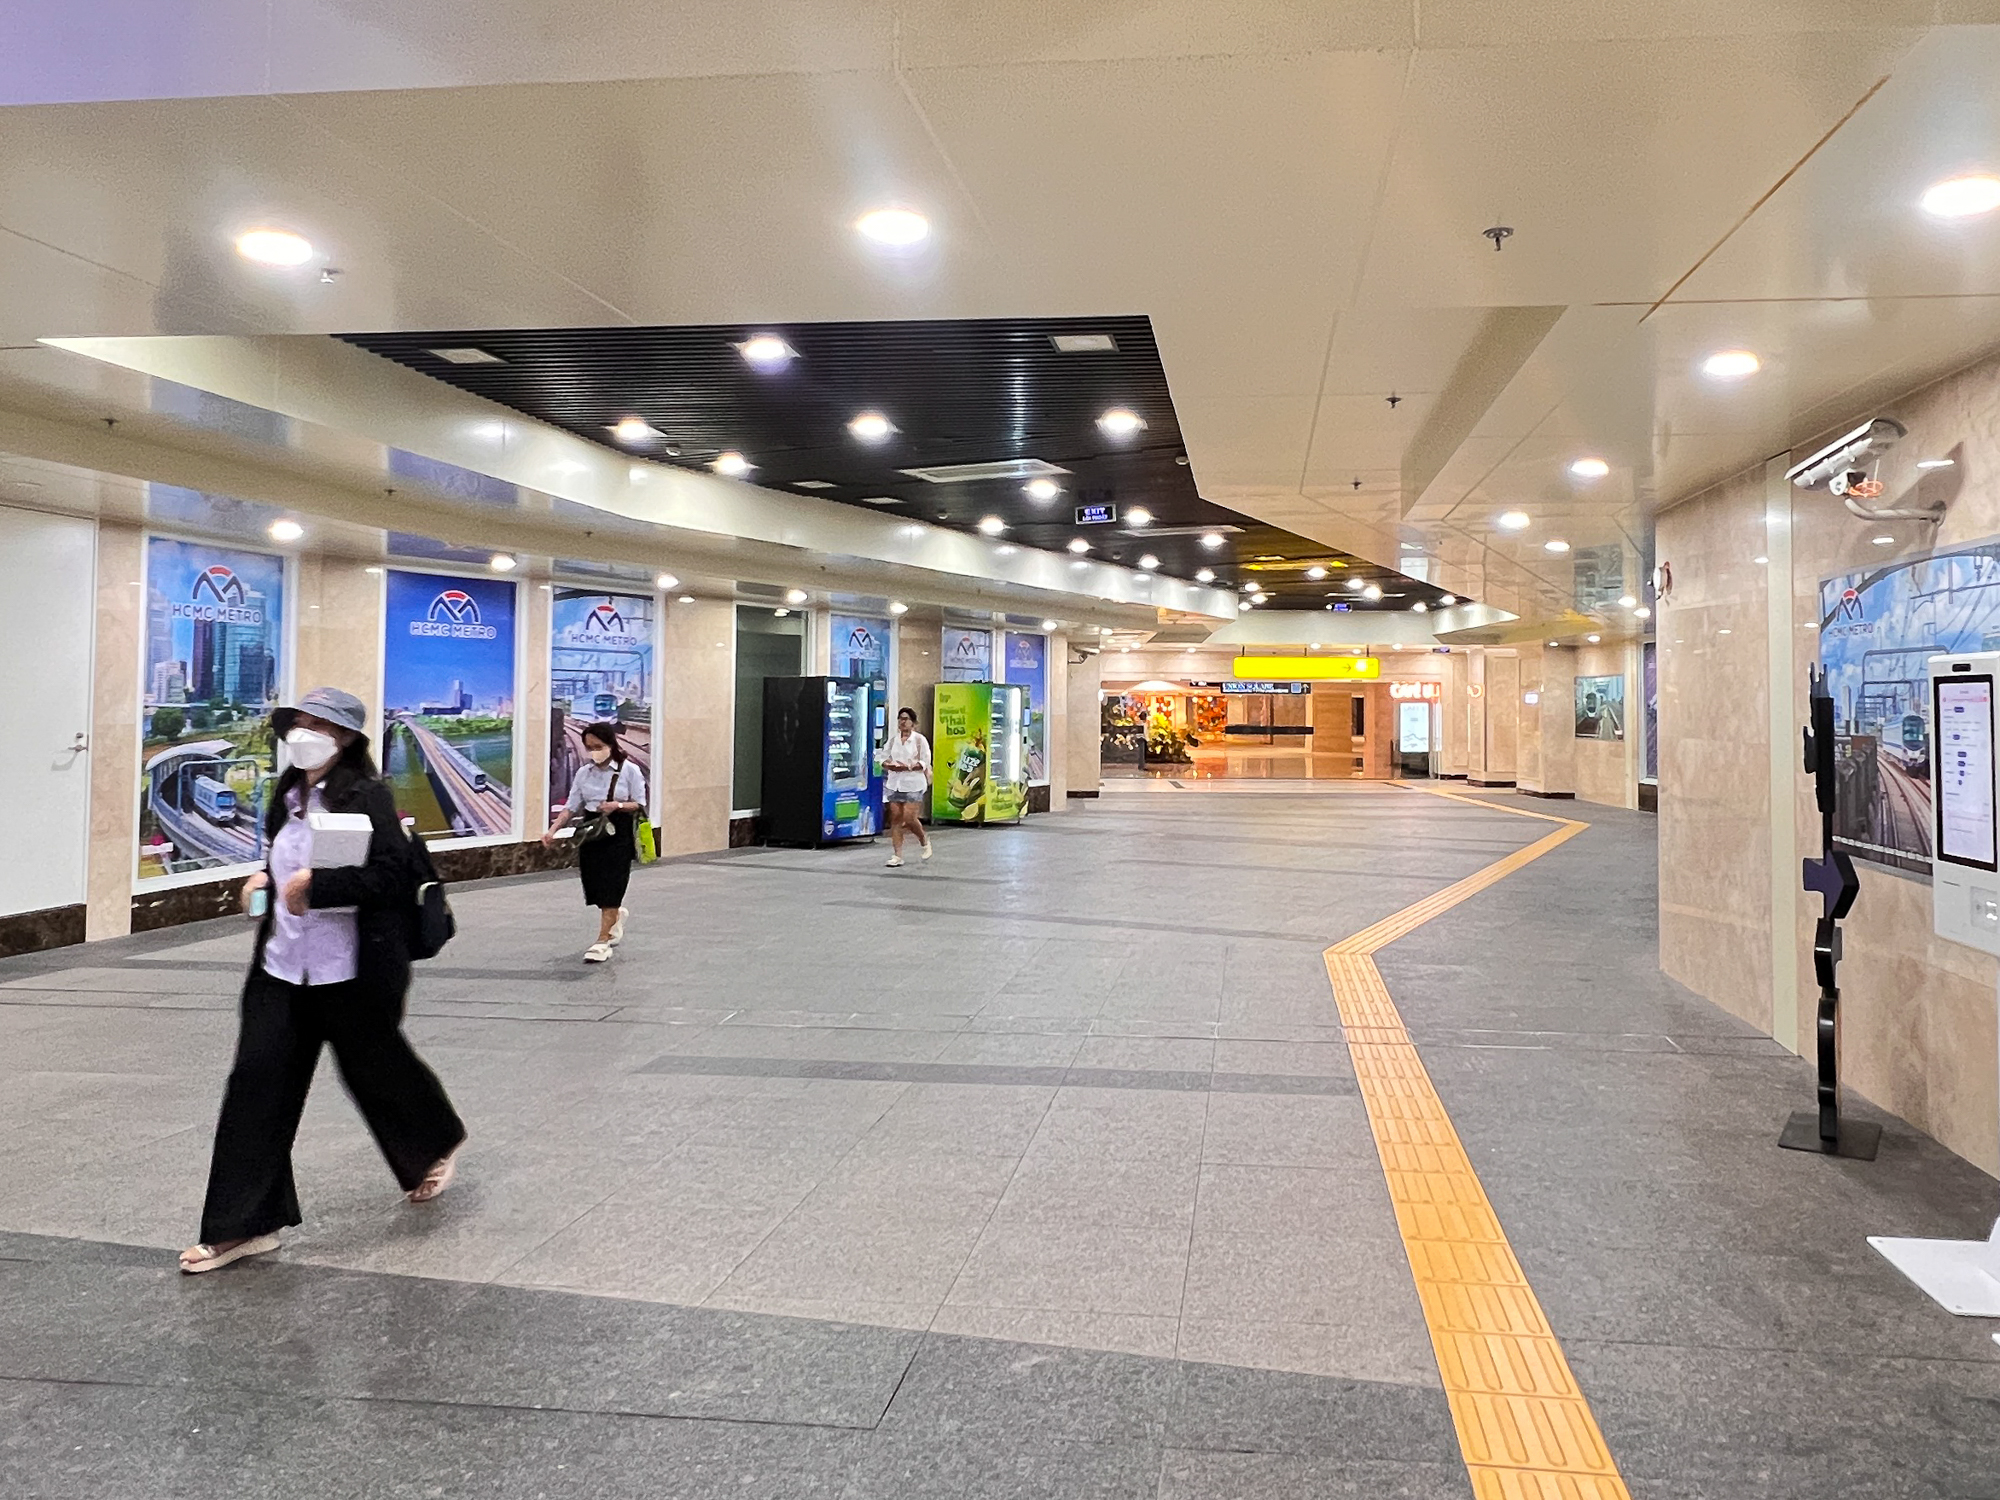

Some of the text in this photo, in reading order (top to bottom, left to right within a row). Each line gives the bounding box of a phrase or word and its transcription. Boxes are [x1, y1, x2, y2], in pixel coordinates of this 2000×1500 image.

[1084, 507, 1105, 516] EXIT
[172, 604, 262, 623] HCMC METRO
[410, 622, 497, 639] HCMC METRO
[1849, 623, 1874, 636] METRO
[571, 633, 638, 646] HCMC METRO
